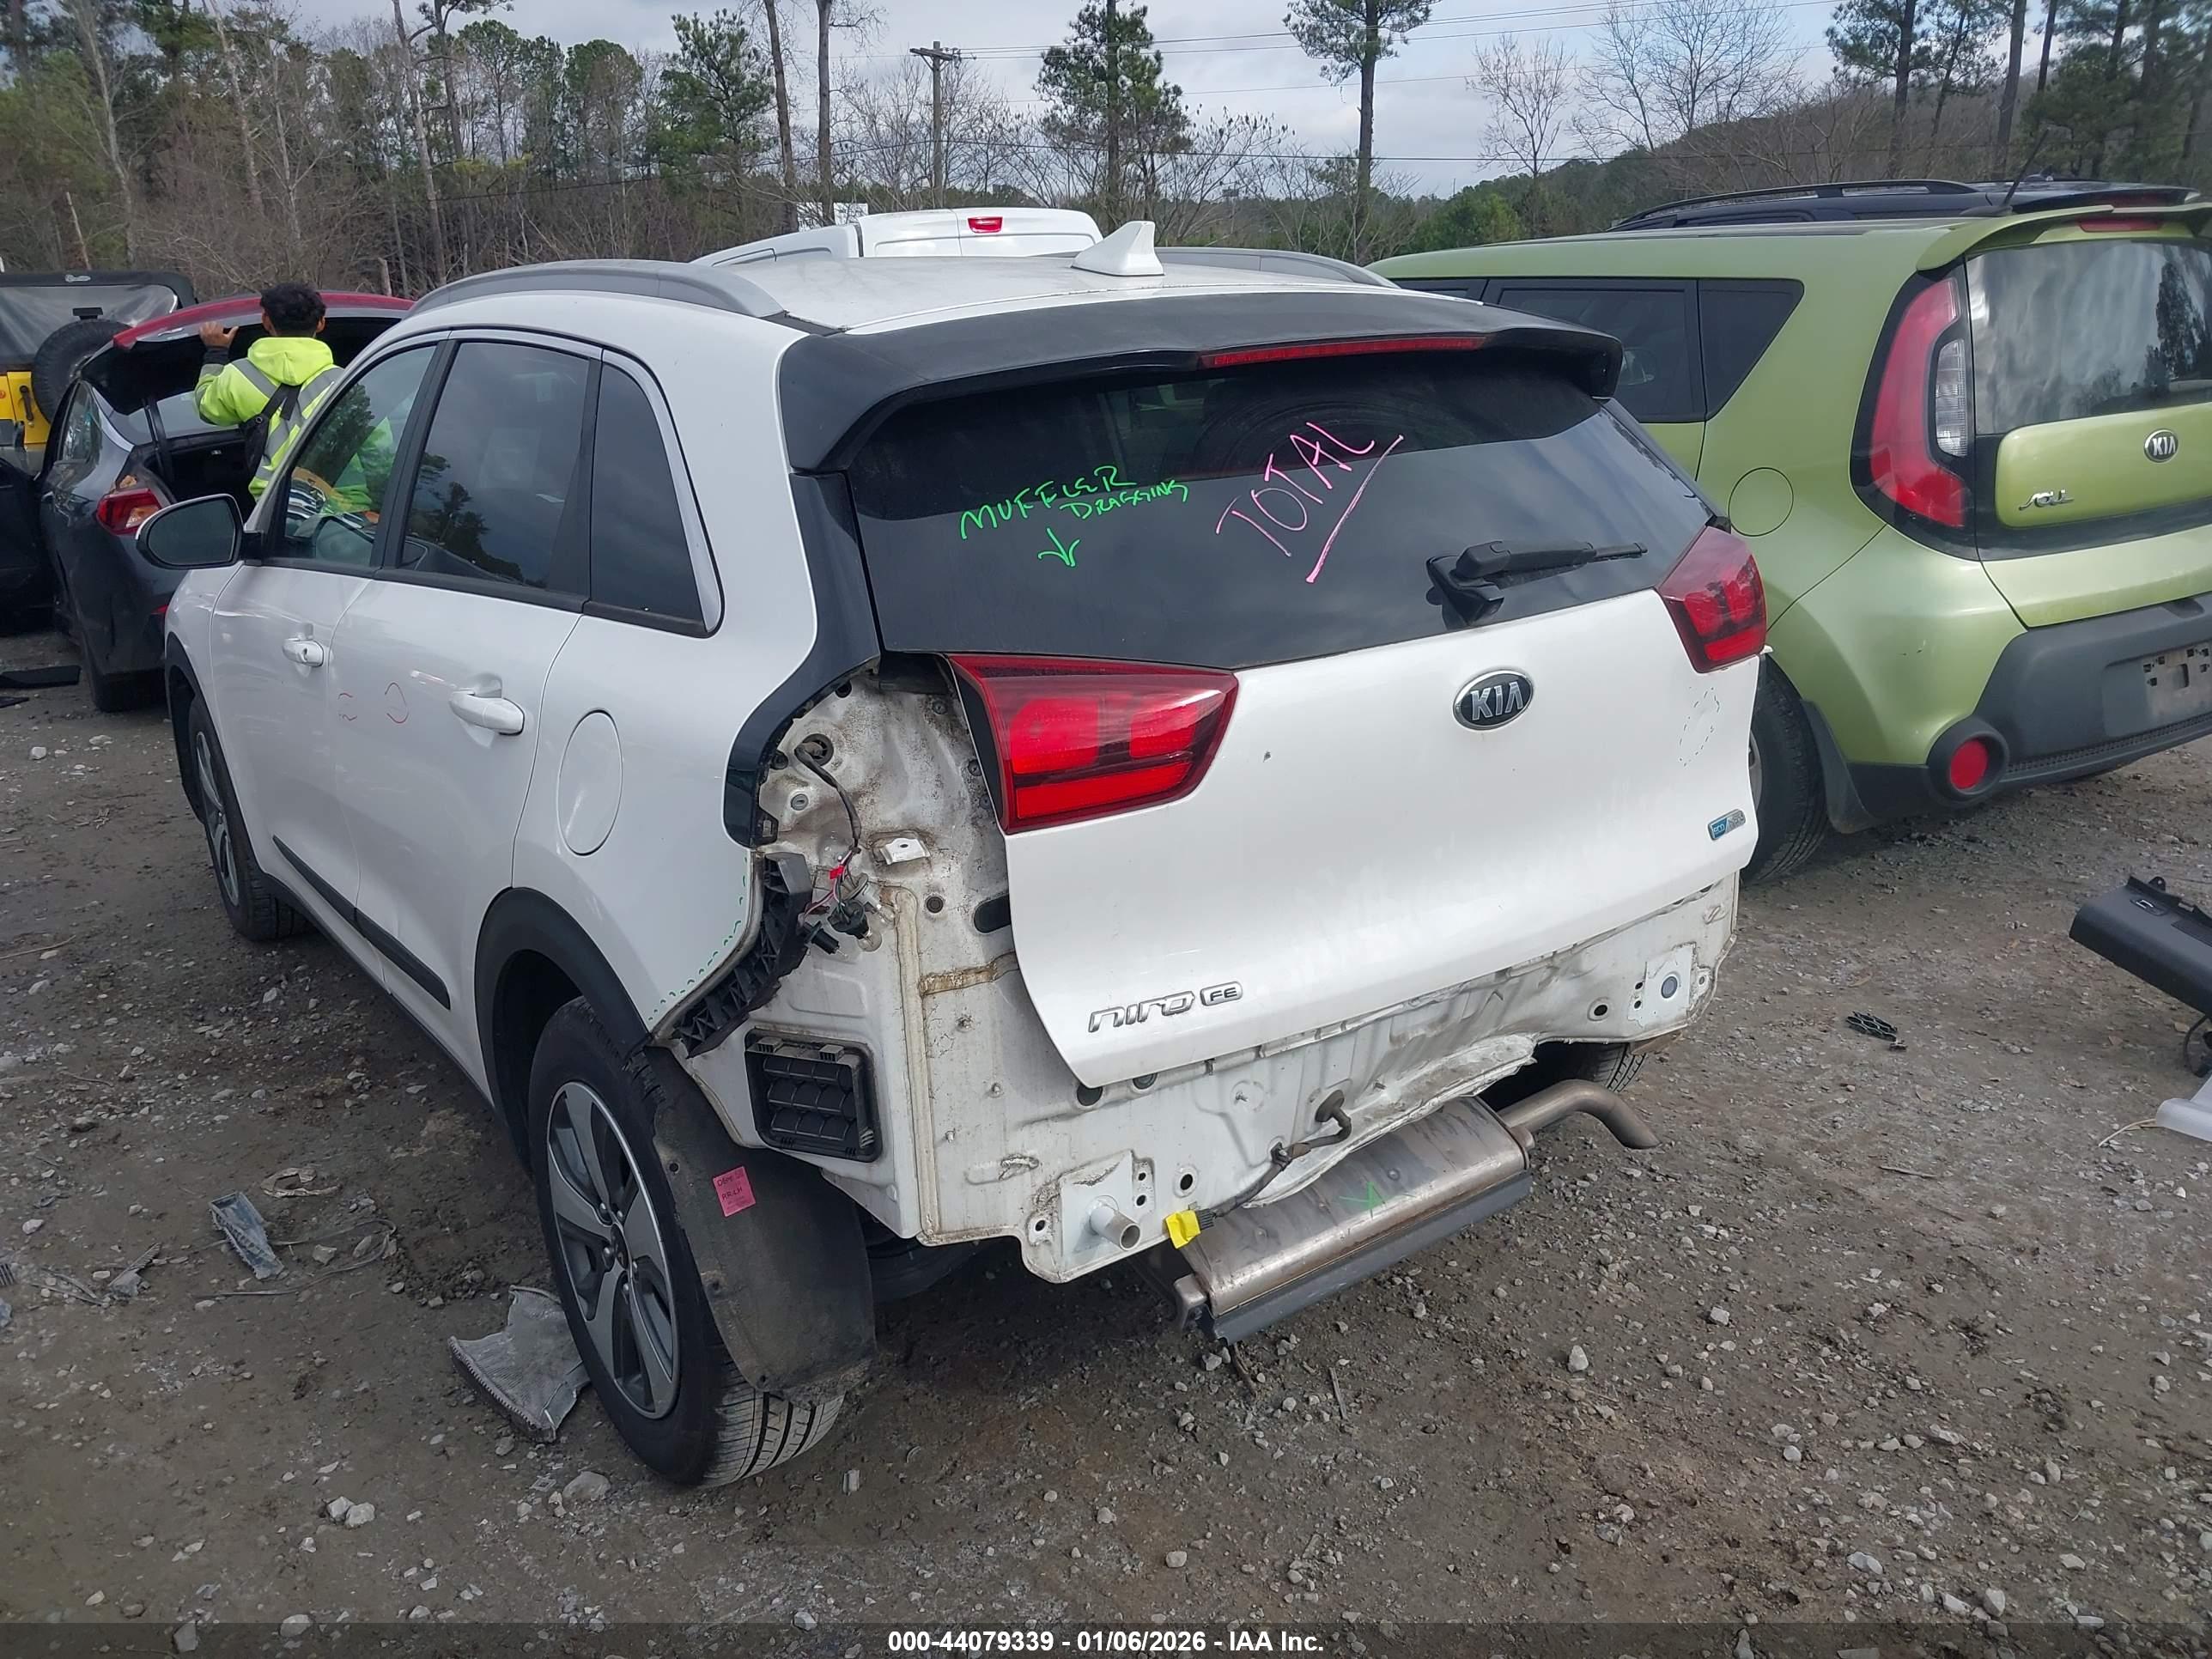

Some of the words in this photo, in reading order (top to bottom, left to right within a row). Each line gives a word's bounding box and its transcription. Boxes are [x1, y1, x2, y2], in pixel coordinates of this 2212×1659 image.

[2152, 435, 2176, 456] KIA
[960, 465, 1138, 540] MUFFLER
[1059, 479, 1189, 520] DRAGGING
[1215, 422, 1374, 557] TOTAL
[1470, 681, 1524, 721] KIA
[1209, 987, 1238, 1002] FE
